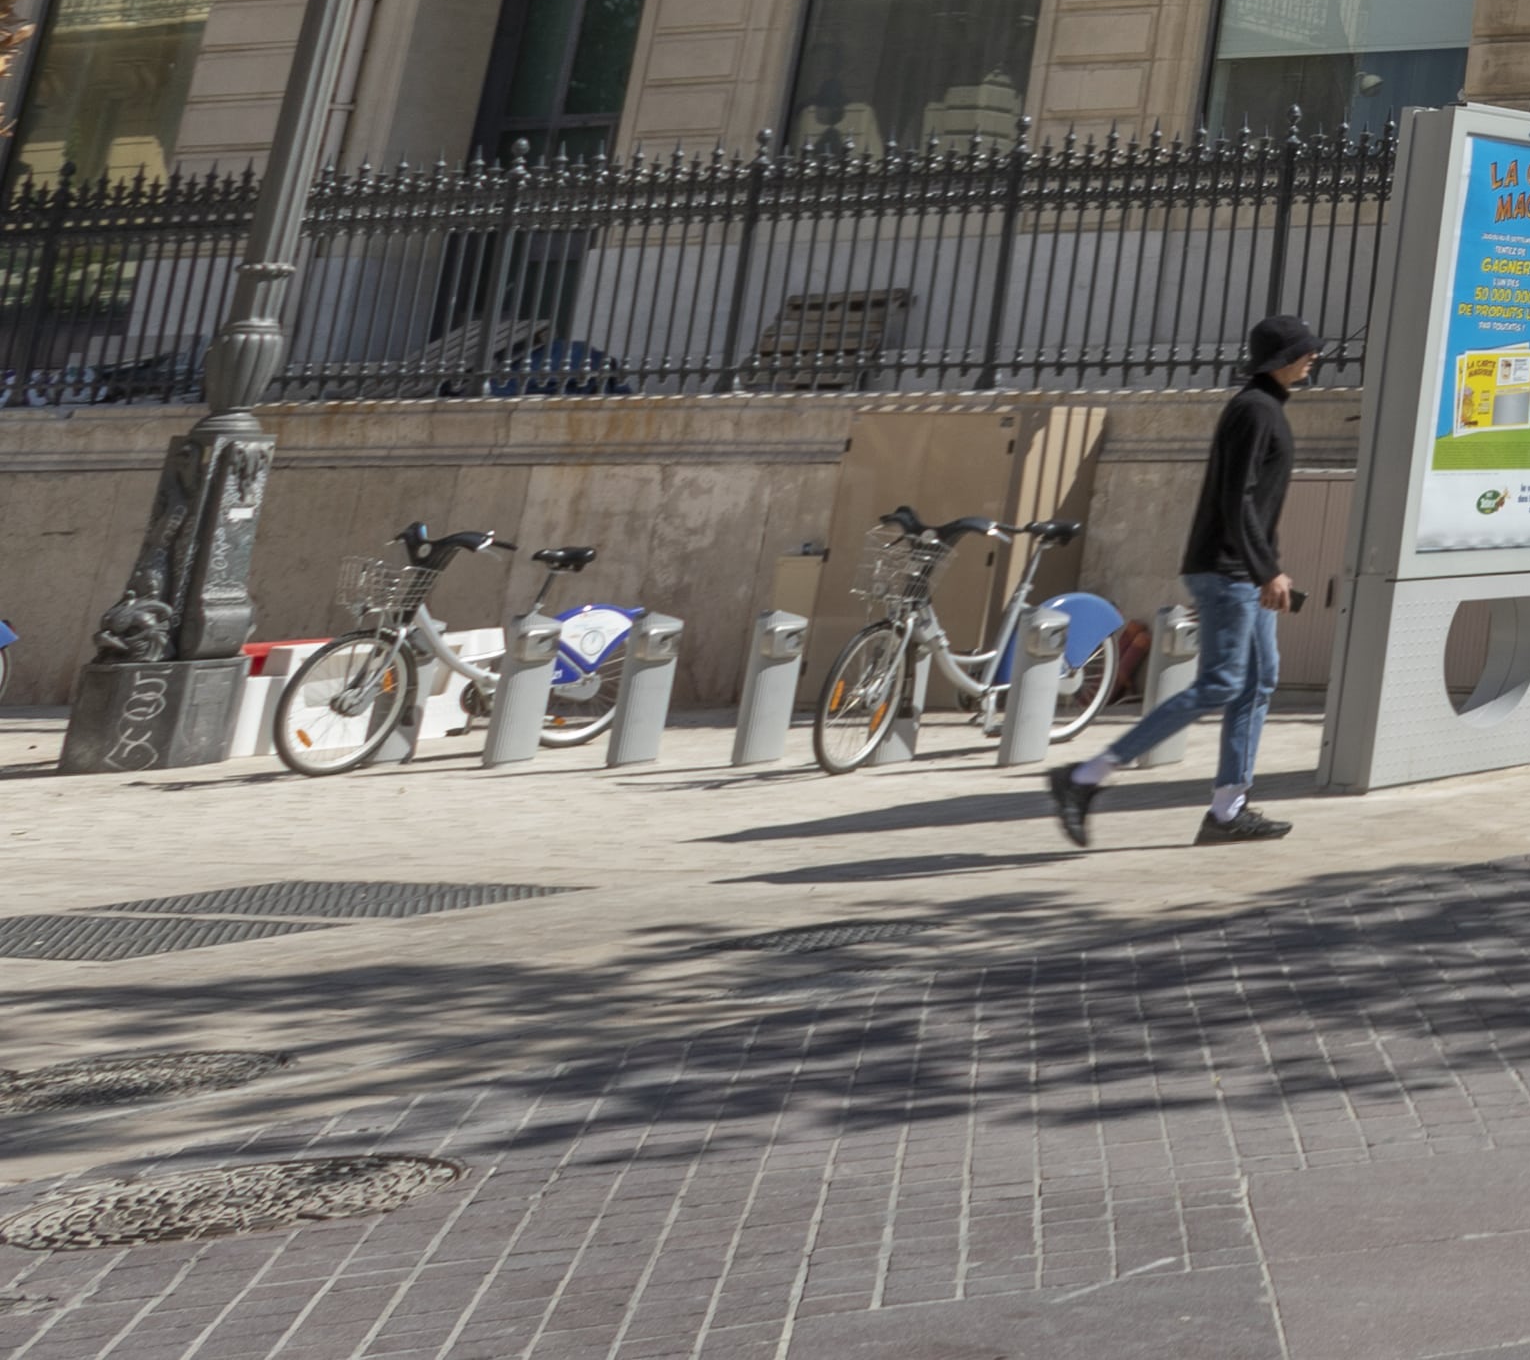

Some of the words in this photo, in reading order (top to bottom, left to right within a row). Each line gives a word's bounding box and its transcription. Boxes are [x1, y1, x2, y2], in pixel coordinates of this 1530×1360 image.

[1490, 159, 1519, 191] LA
[1495, 245, 1517, 255] TENTEZ
[1474, 286, 1489, 301] 50
[1491, 287, 1512, 302] 000
[1458, 303, 1473, 317] DE
